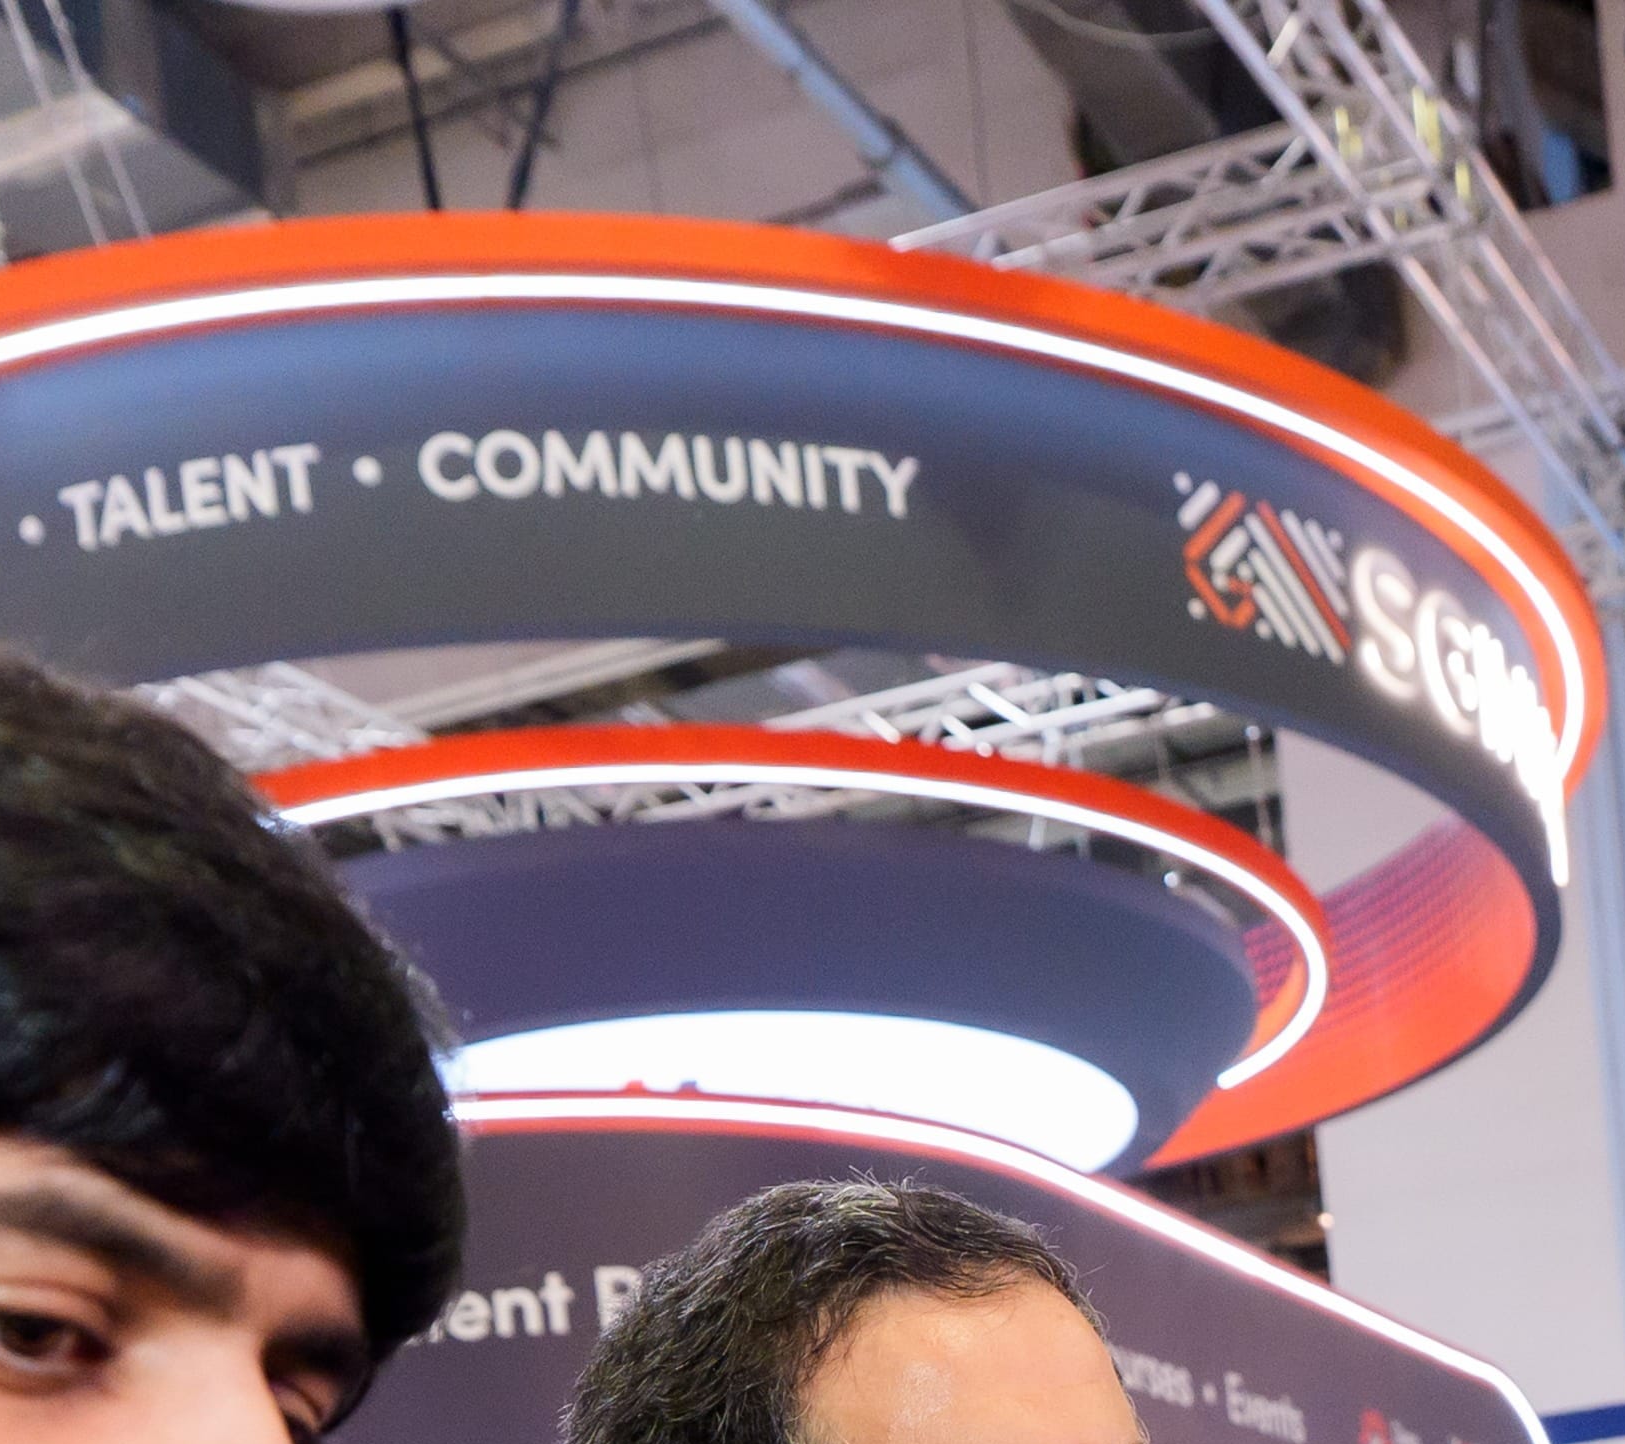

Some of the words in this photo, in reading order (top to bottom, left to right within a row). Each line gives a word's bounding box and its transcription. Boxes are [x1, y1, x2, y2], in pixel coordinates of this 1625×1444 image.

[57, 441, 322, 552] TALENT
[417, 428, 921, 520] COMMUNITY
[427, 1270, 575, 1343] ent
